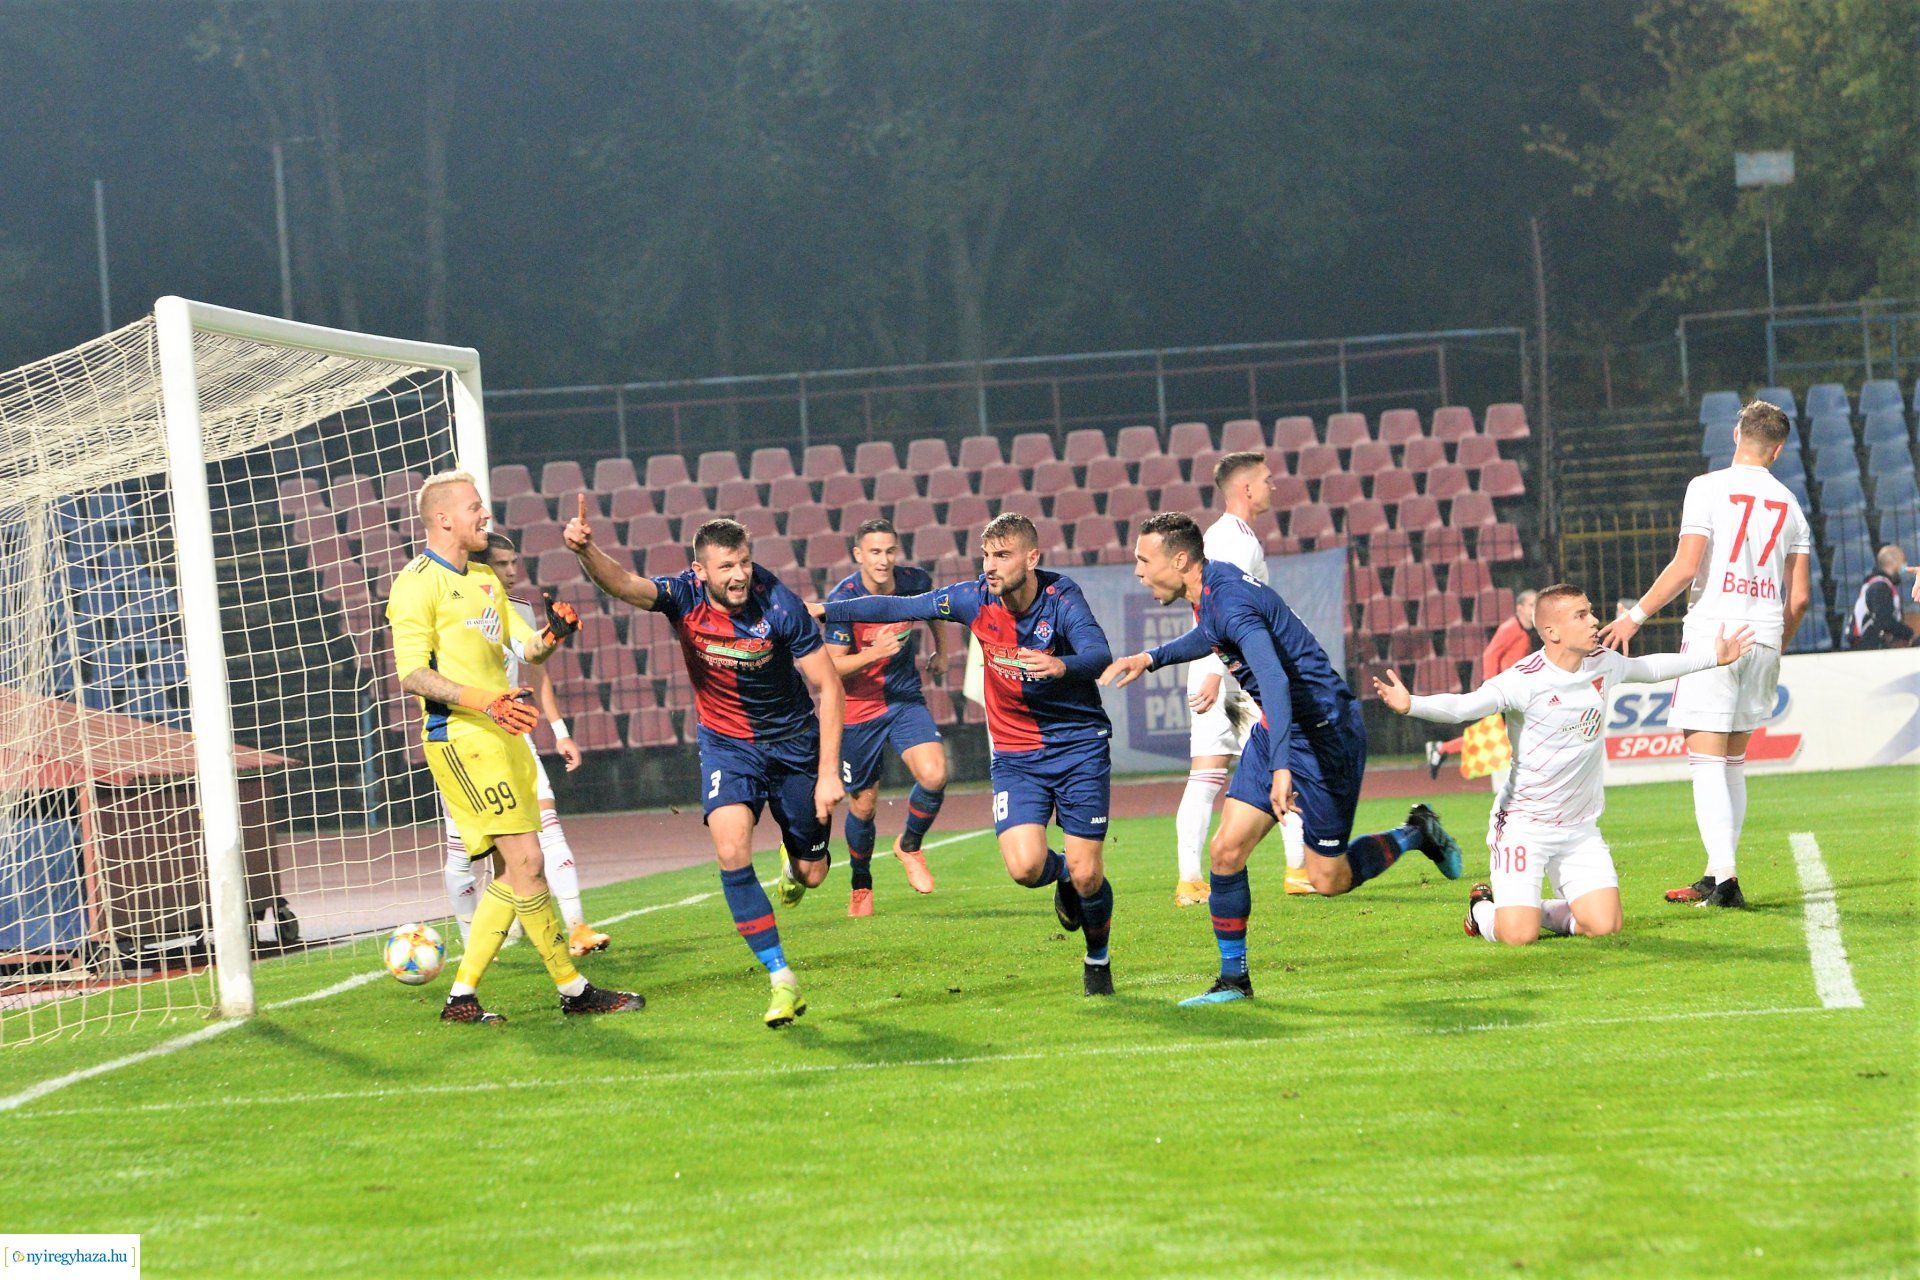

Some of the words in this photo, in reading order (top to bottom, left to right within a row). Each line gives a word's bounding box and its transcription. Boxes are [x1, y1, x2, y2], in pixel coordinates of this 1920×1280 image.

[1729, 494, 1788, 567] 77
[1722, 572, 1776, 600] Baáth
[1145, 689, 1191, 729] PÁ
[1616, 735, 1688, 757] SPOR
[708, 770, 721, 799] 3
[843, 761, 852, 783] 5
[485, 781, 516, 815] 99
[1504, 846, 1526, 874] 18
